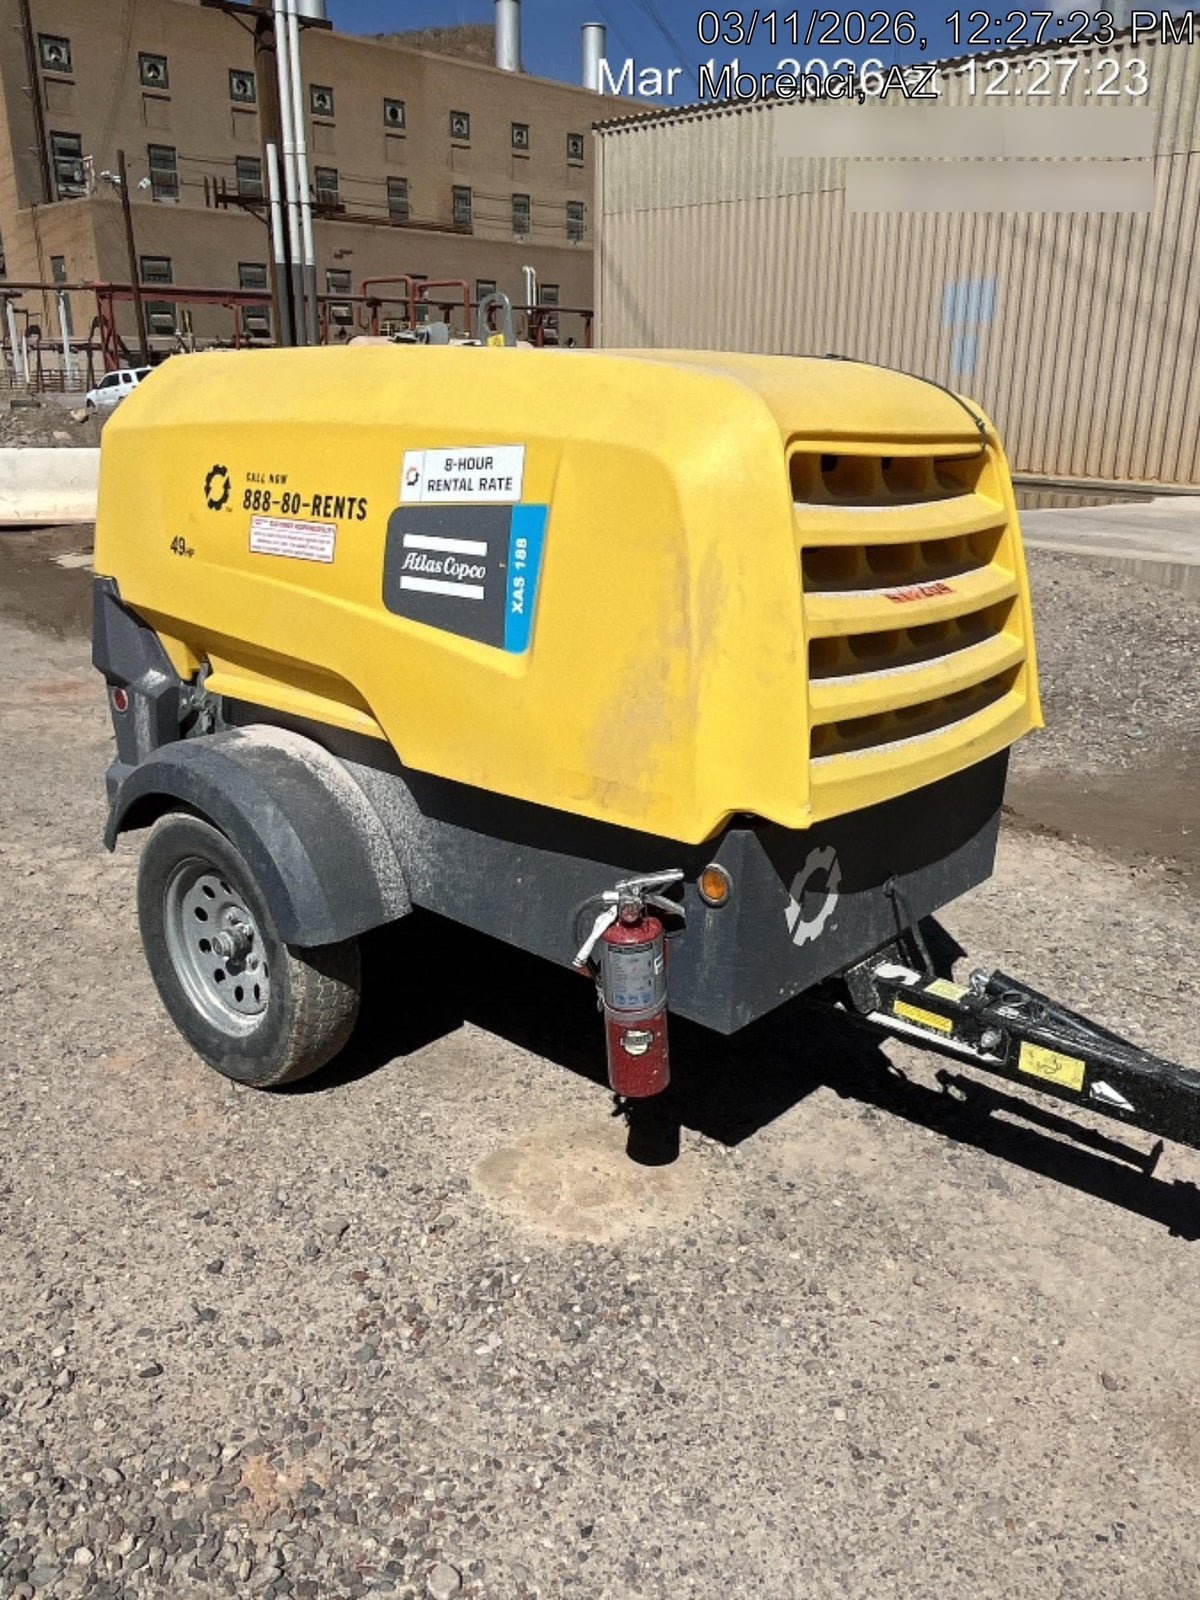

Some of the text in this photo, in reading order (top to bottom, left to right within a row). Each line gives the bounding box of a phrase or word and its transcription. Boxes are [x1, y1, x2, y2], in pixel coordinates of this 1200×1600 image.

[444, 456, 493, 472] 8-HOUR
[427, 477, 512, 492] RENTAL RATE
[243, 488, 368, 521] 888-80-RENTS
[401, 552, 487, 580] Atlas Copco
[512, 577, 526, 614] XAS
